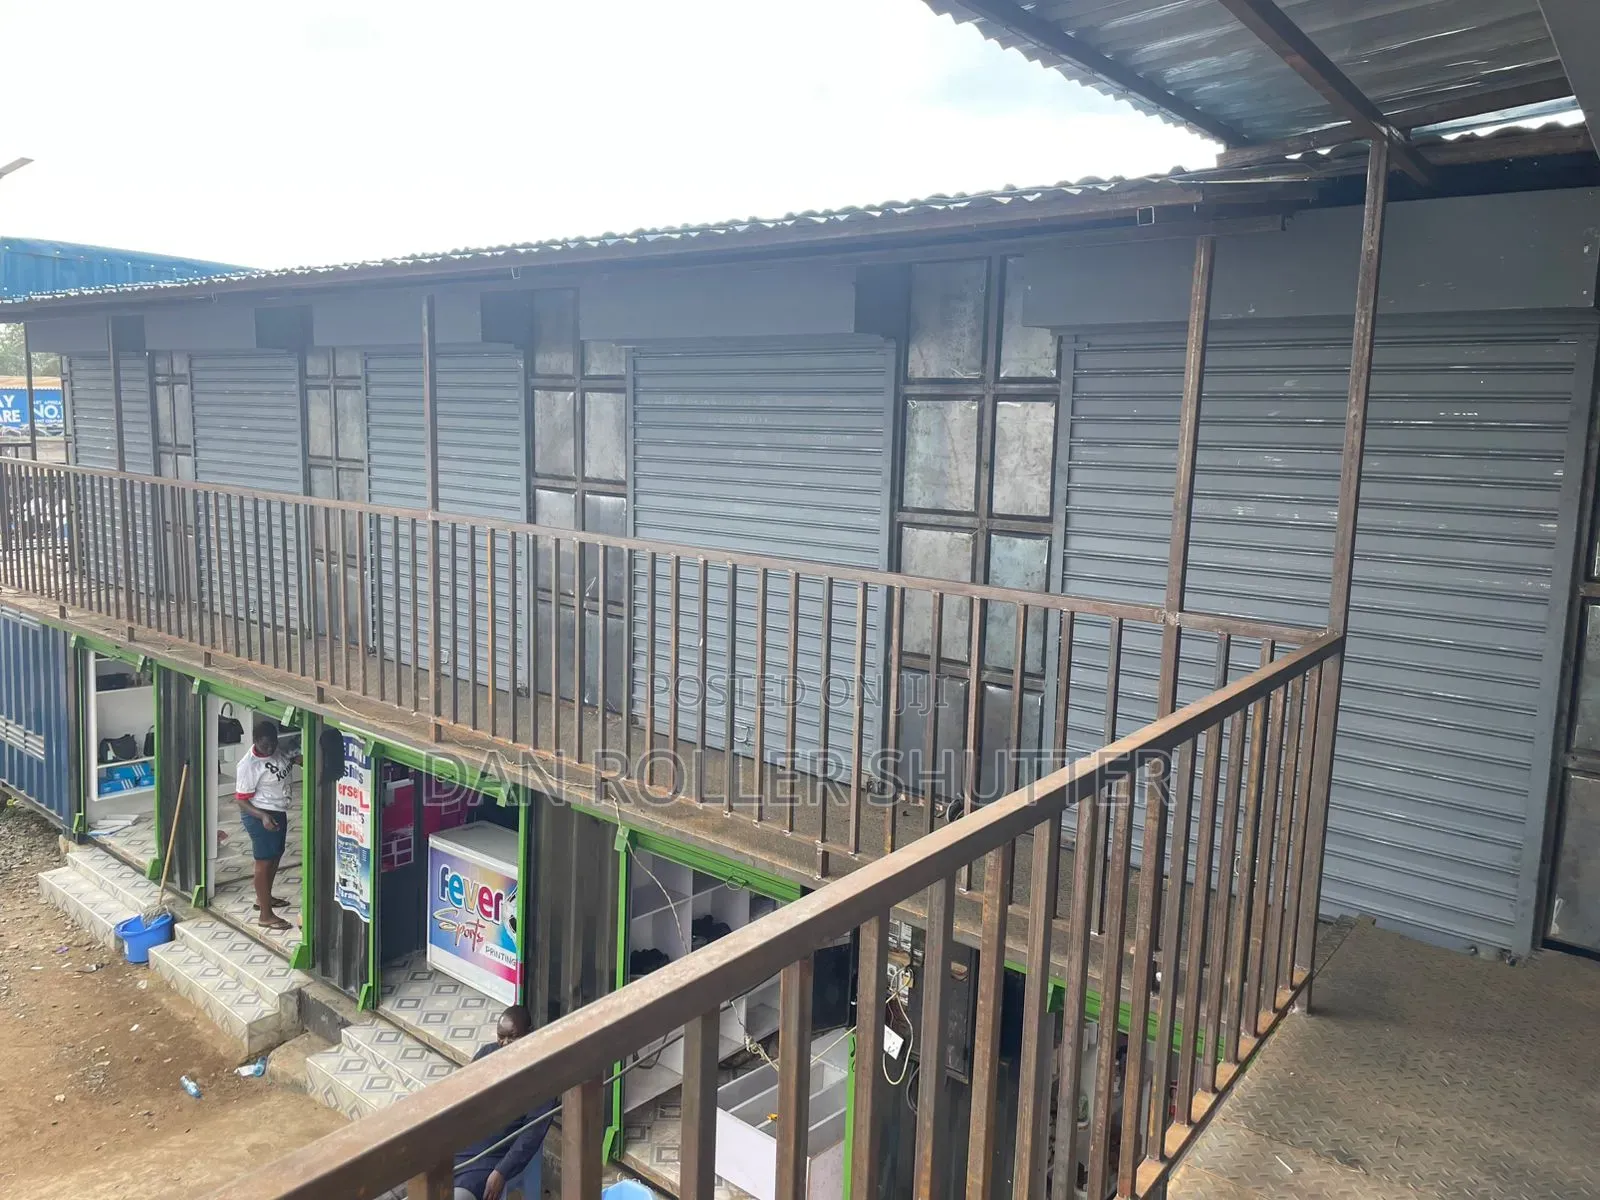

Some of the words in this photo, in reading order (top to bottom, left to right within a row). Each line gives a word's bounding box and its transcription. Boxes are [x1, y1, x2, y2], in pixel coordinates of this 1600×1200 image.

[438, 864, 505, 924] fever
[433, 907, 485, 953] Sports
[485, 945, 517, 967] PRINTING
